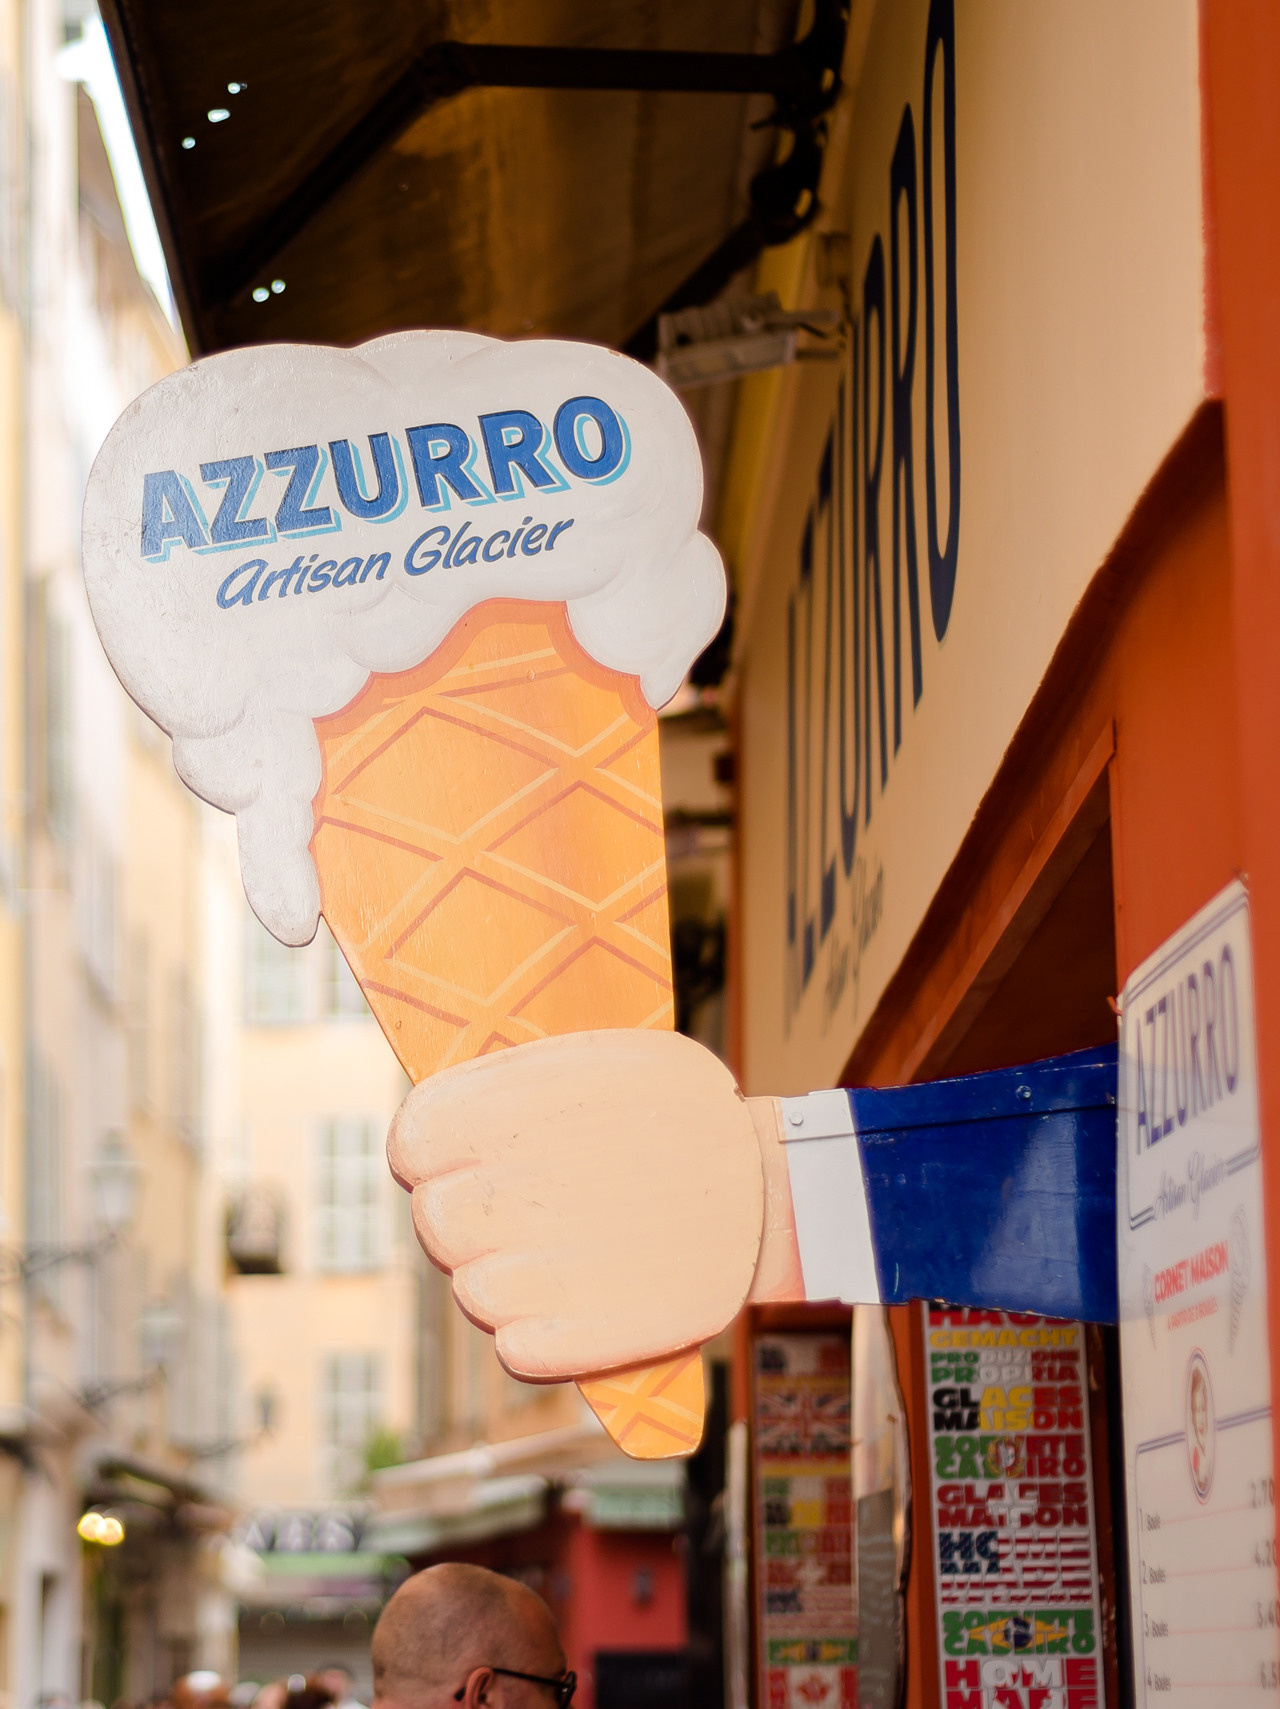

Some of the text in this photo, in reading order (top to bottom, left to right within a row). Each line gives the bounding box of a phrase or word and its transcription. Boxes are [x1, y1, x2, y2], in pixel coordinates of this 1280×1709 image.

[139, 395, 632, 565] AZZURRO
[216, 516, 576, 610] Artisan Glacier
[1135, 942, 1240, 1157] AZZURRO
[1153, 1239, 1228, 1304] CORNET MAISON
[930, 1328, 1079, 1348] GEMACHT
[931, 1349, 1079, 1364] PRODUZIONE
[931, 1364, 1079, 1384] PROPRIA
[933, 1386, 1083, 1409] GLACES
[934, 1408, 1083, 1432] MAISON
[937, 1483, 1088, 1506] GLACES
[938, 1505, 1088, 1529] MAISON
[939, 1529, 1090, 1560] HOME
[940, 1559, 1091, 1589] MADE
[1149, 1565, 1167, 1585] Boules
[942, 1609, 1094, 1633] SORVETE
[1151, 1618, 1169, 1638] Boules
[944, 1631, 1096, 1656] CASEIRO
[945, 1658, 1097, 1688] HOME
[1154, 1673, 1172, 1691] Boules
[946, 1687, 1099, 1709] MADE
